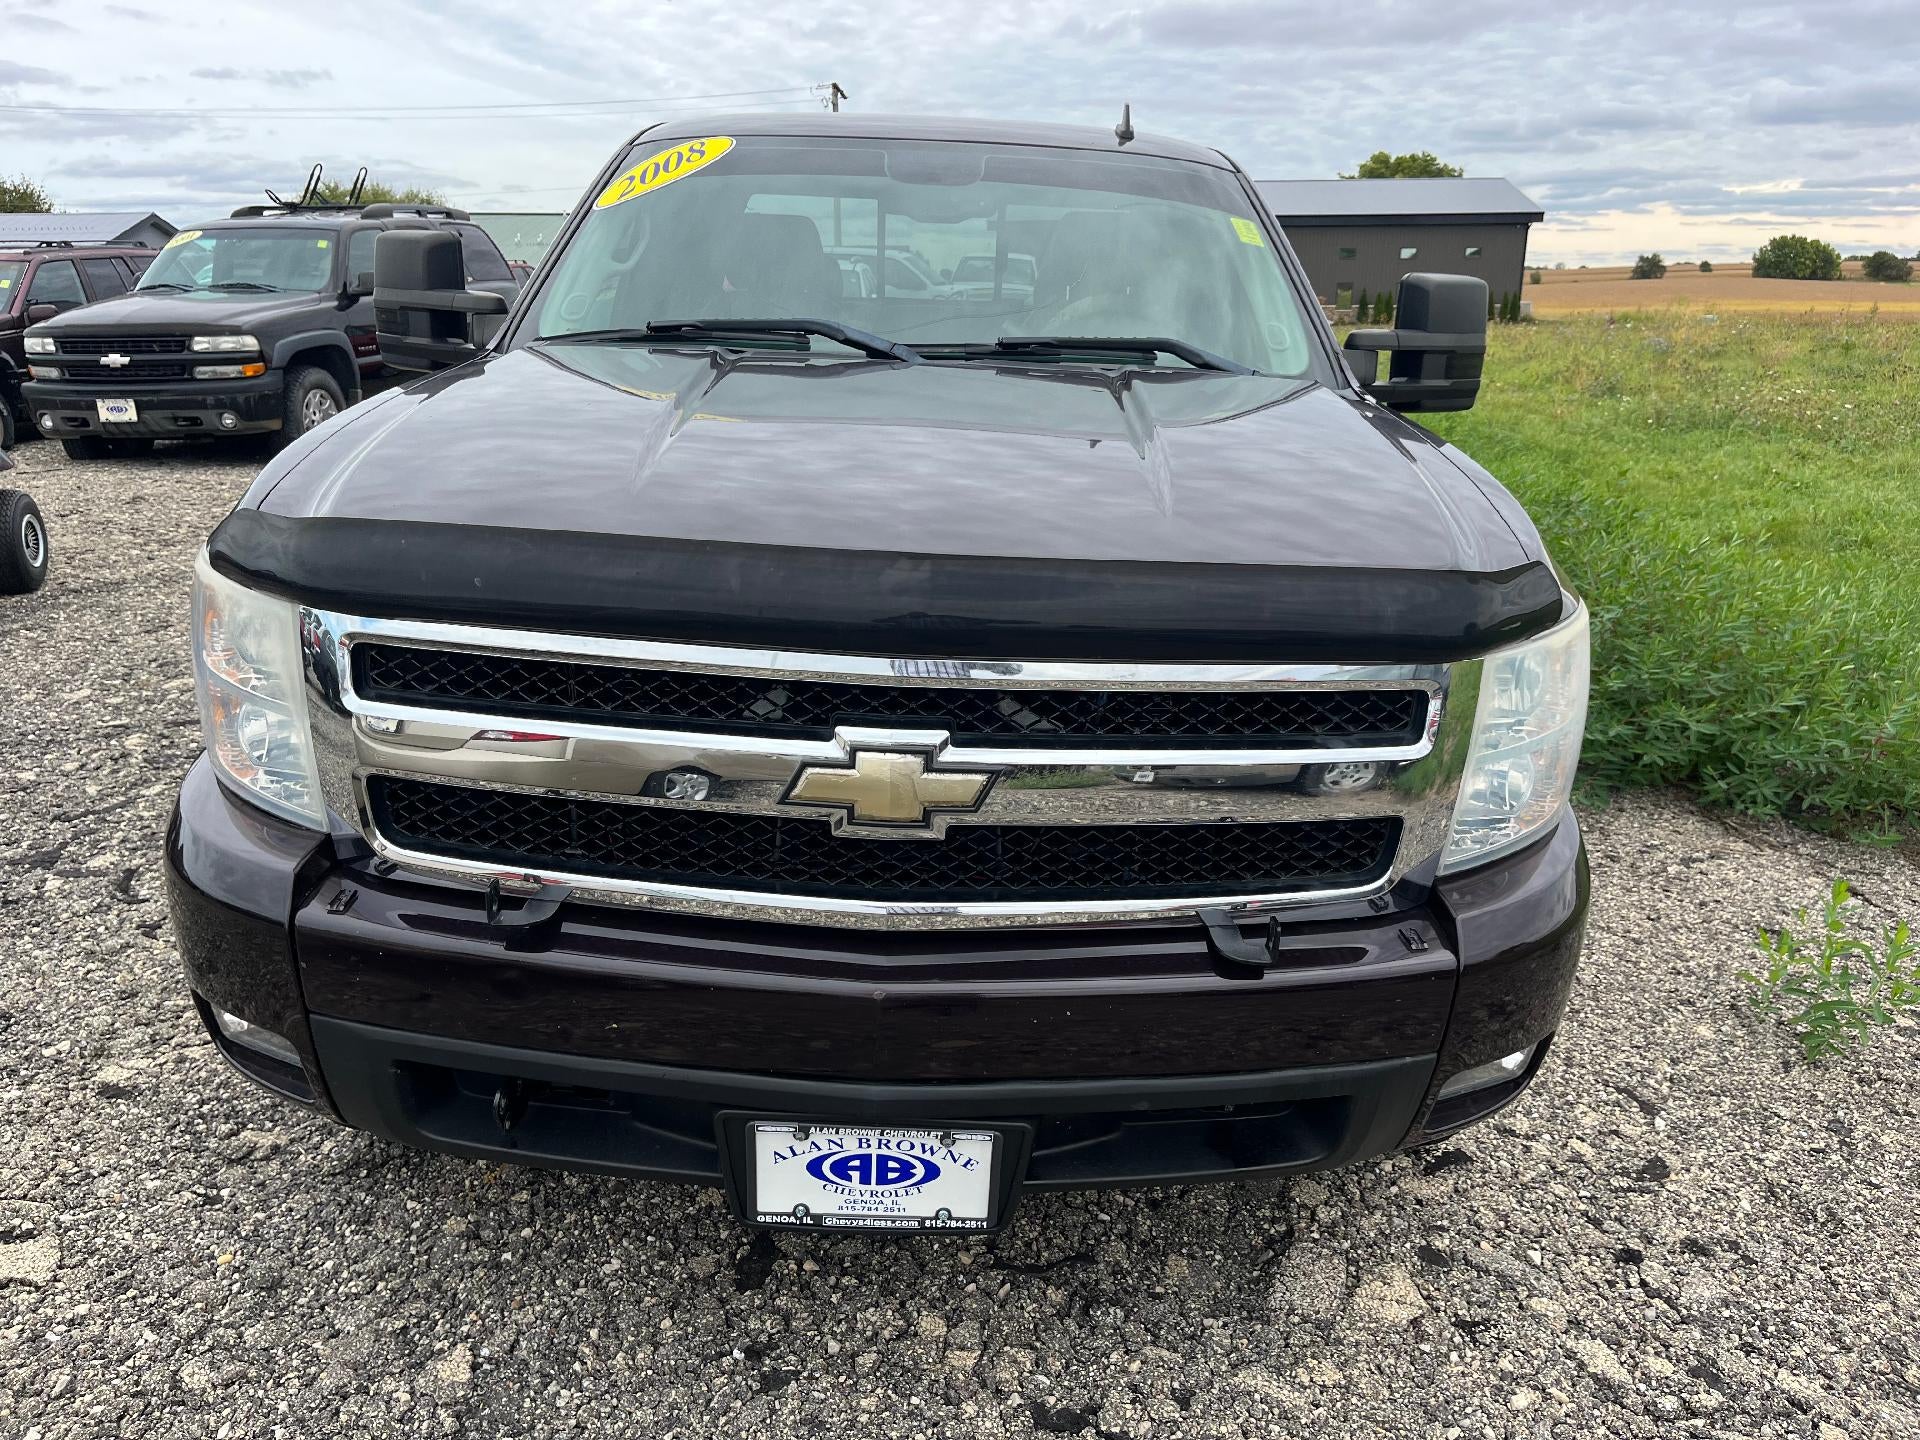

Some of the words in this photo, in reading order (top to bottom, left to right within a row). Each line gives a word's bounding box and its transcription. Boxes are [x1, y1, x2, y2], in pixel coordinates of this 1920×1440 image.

[616, 141, 706, 201] 2008
[808, 1126, 837, 1135] ALAN
[838, 1127, 881, 1137] BROWNE
[883, 1129, 943, 1140] CHEVROLET
[772, 1137, 845, 1165] ALAN
[857, 1137, 980, 1172] BROWNE
[829, 1153, 918, 1186] AB
[822, 1183, 924, 1199] CHEVROLET
[837, 1205, 907, 1213] 815-784-2511
[844, 1198, 888, 1207] GENOA,
[756, 1215, 801, 1224] GENOA,
[802, 1216, 814, 1224] IL
[924, 1219, 988, 1229] 815-784-2511
